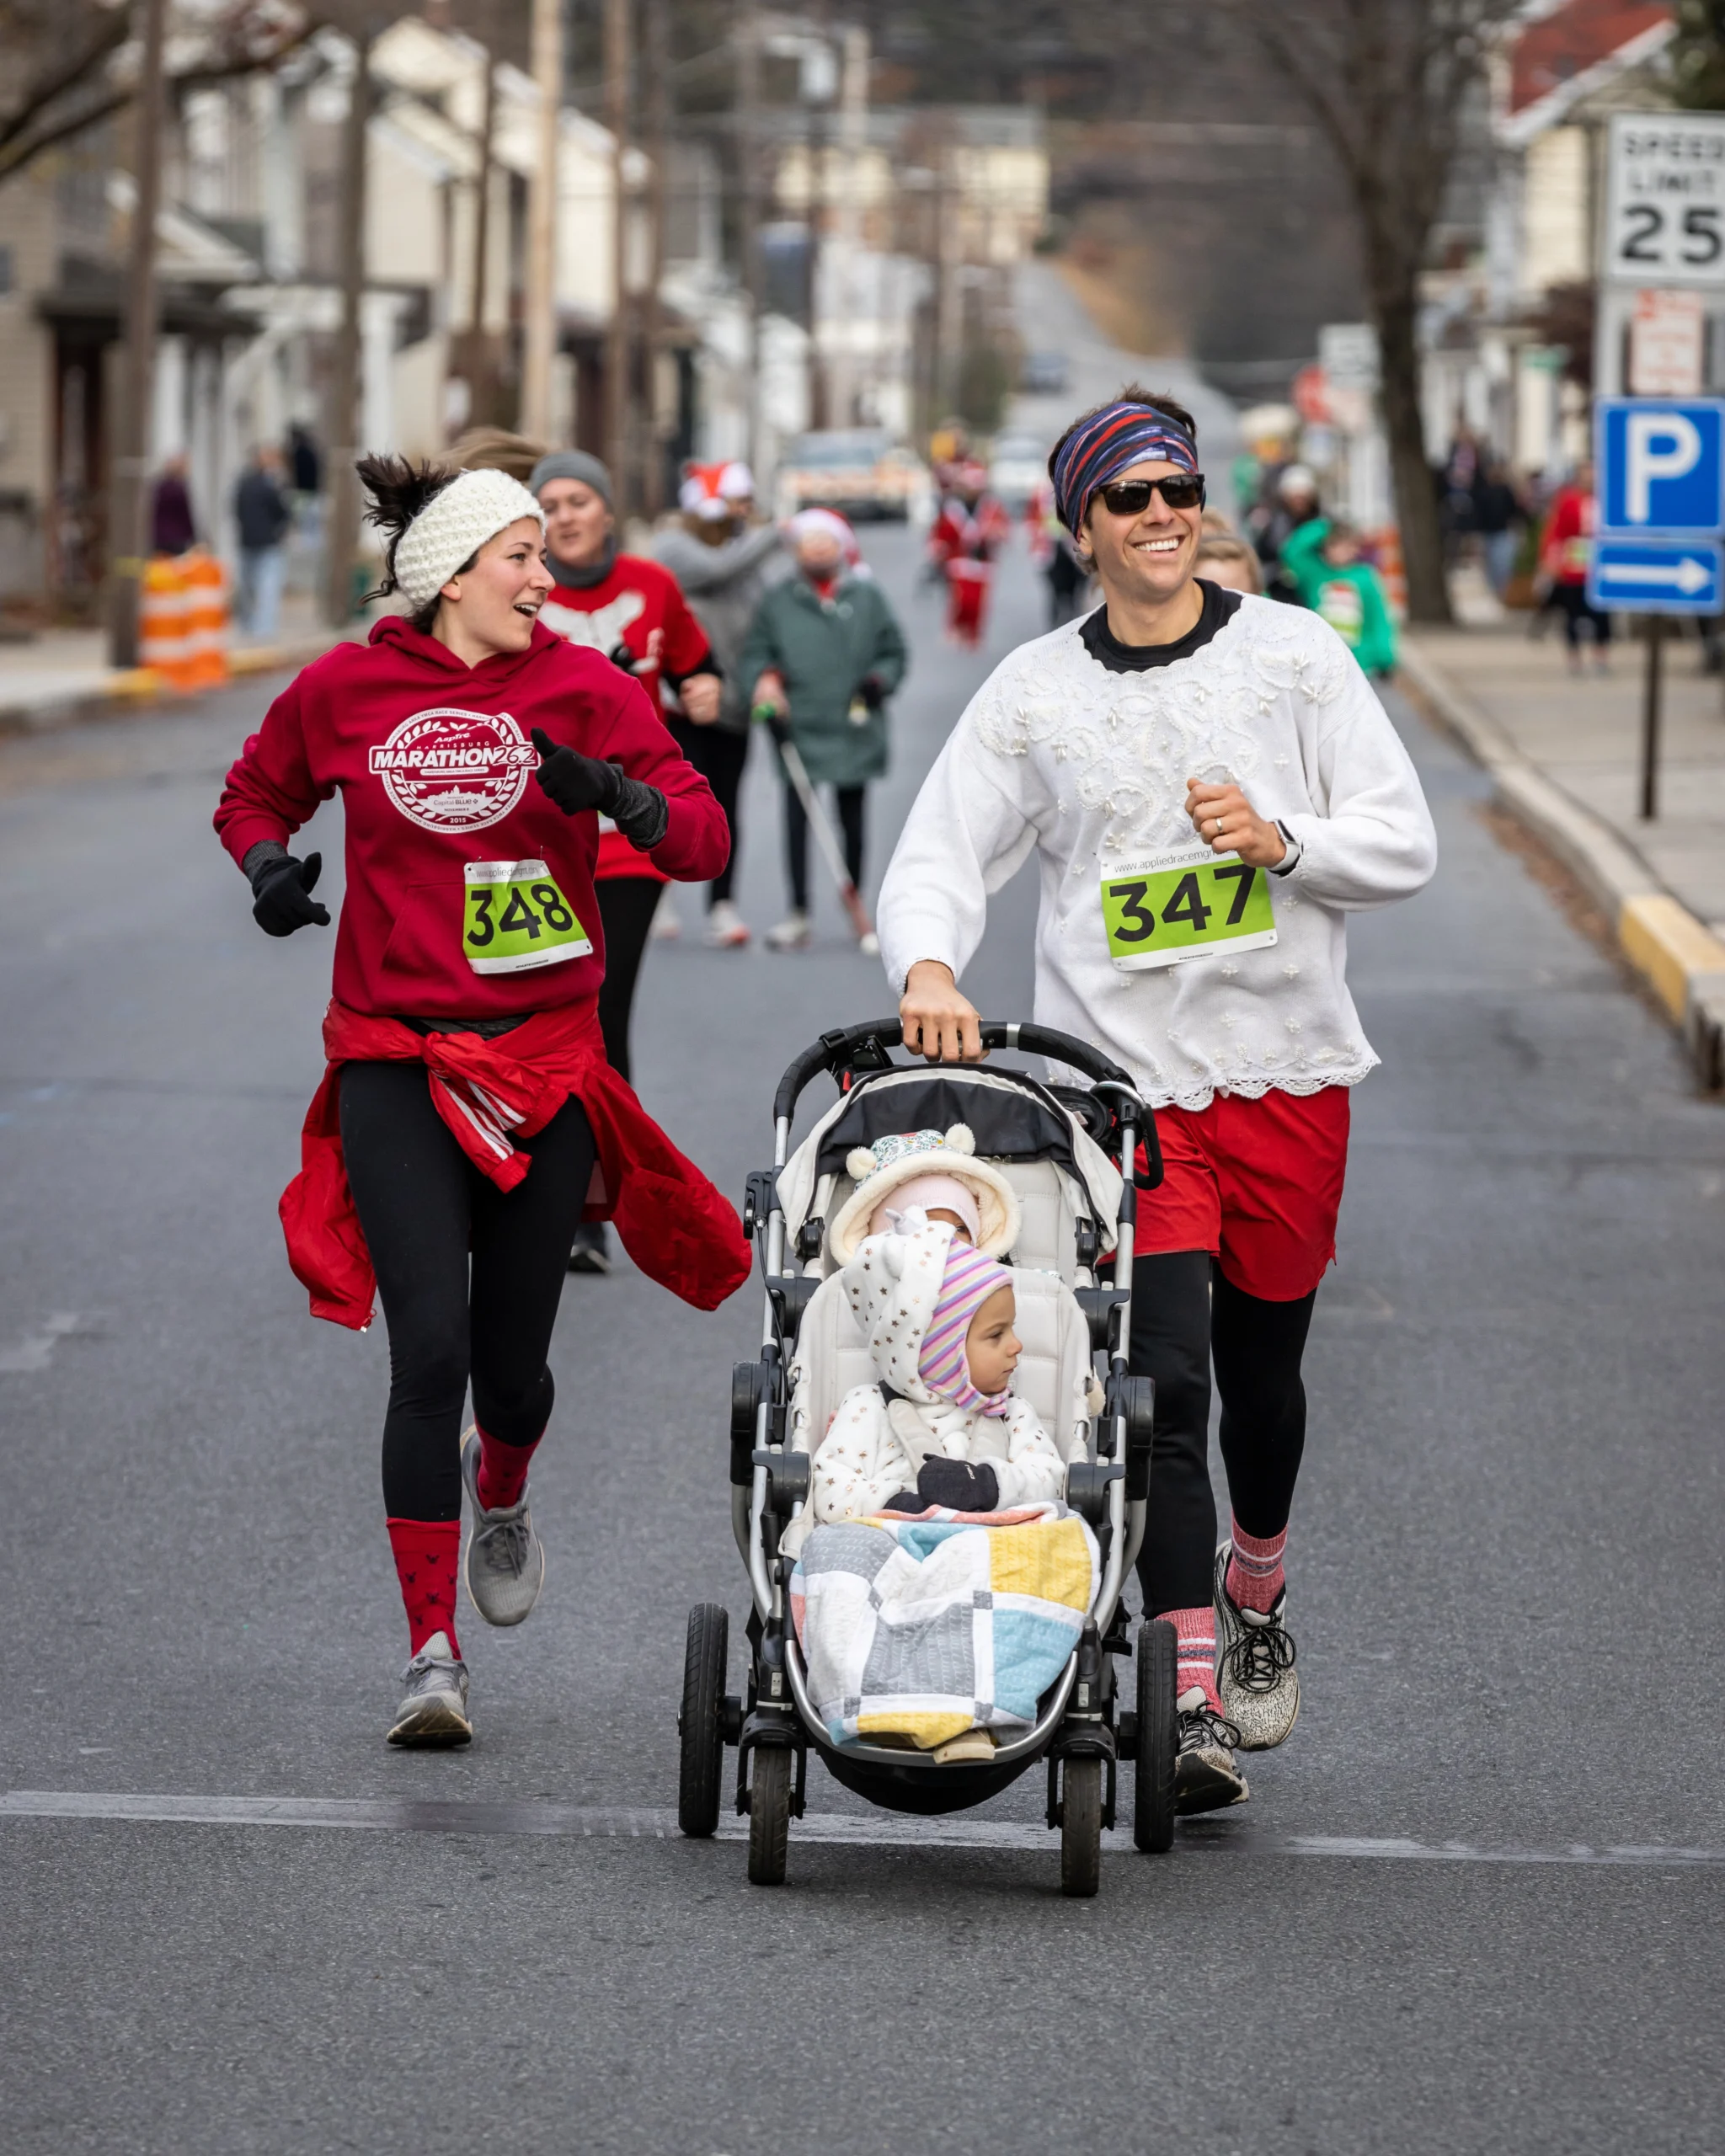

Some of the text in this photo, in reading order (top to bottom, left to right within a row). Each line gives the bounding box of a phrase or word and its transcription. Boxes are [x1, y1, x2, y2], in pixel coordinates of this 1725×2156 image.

[1624, 132, 1725, 160] SPEED
[1626, 168, 1717, 193] LIMIT
[1621, 205, 1723, 264] 25
[1626, 414, 1701, 523] P
[374, 744, 536, 769] MARATHON 26.2
[416, 741, 490, 750] HARRISBURG
[467, 883, 574, 947] 348
[1109, 863, 1257, 942] 347
